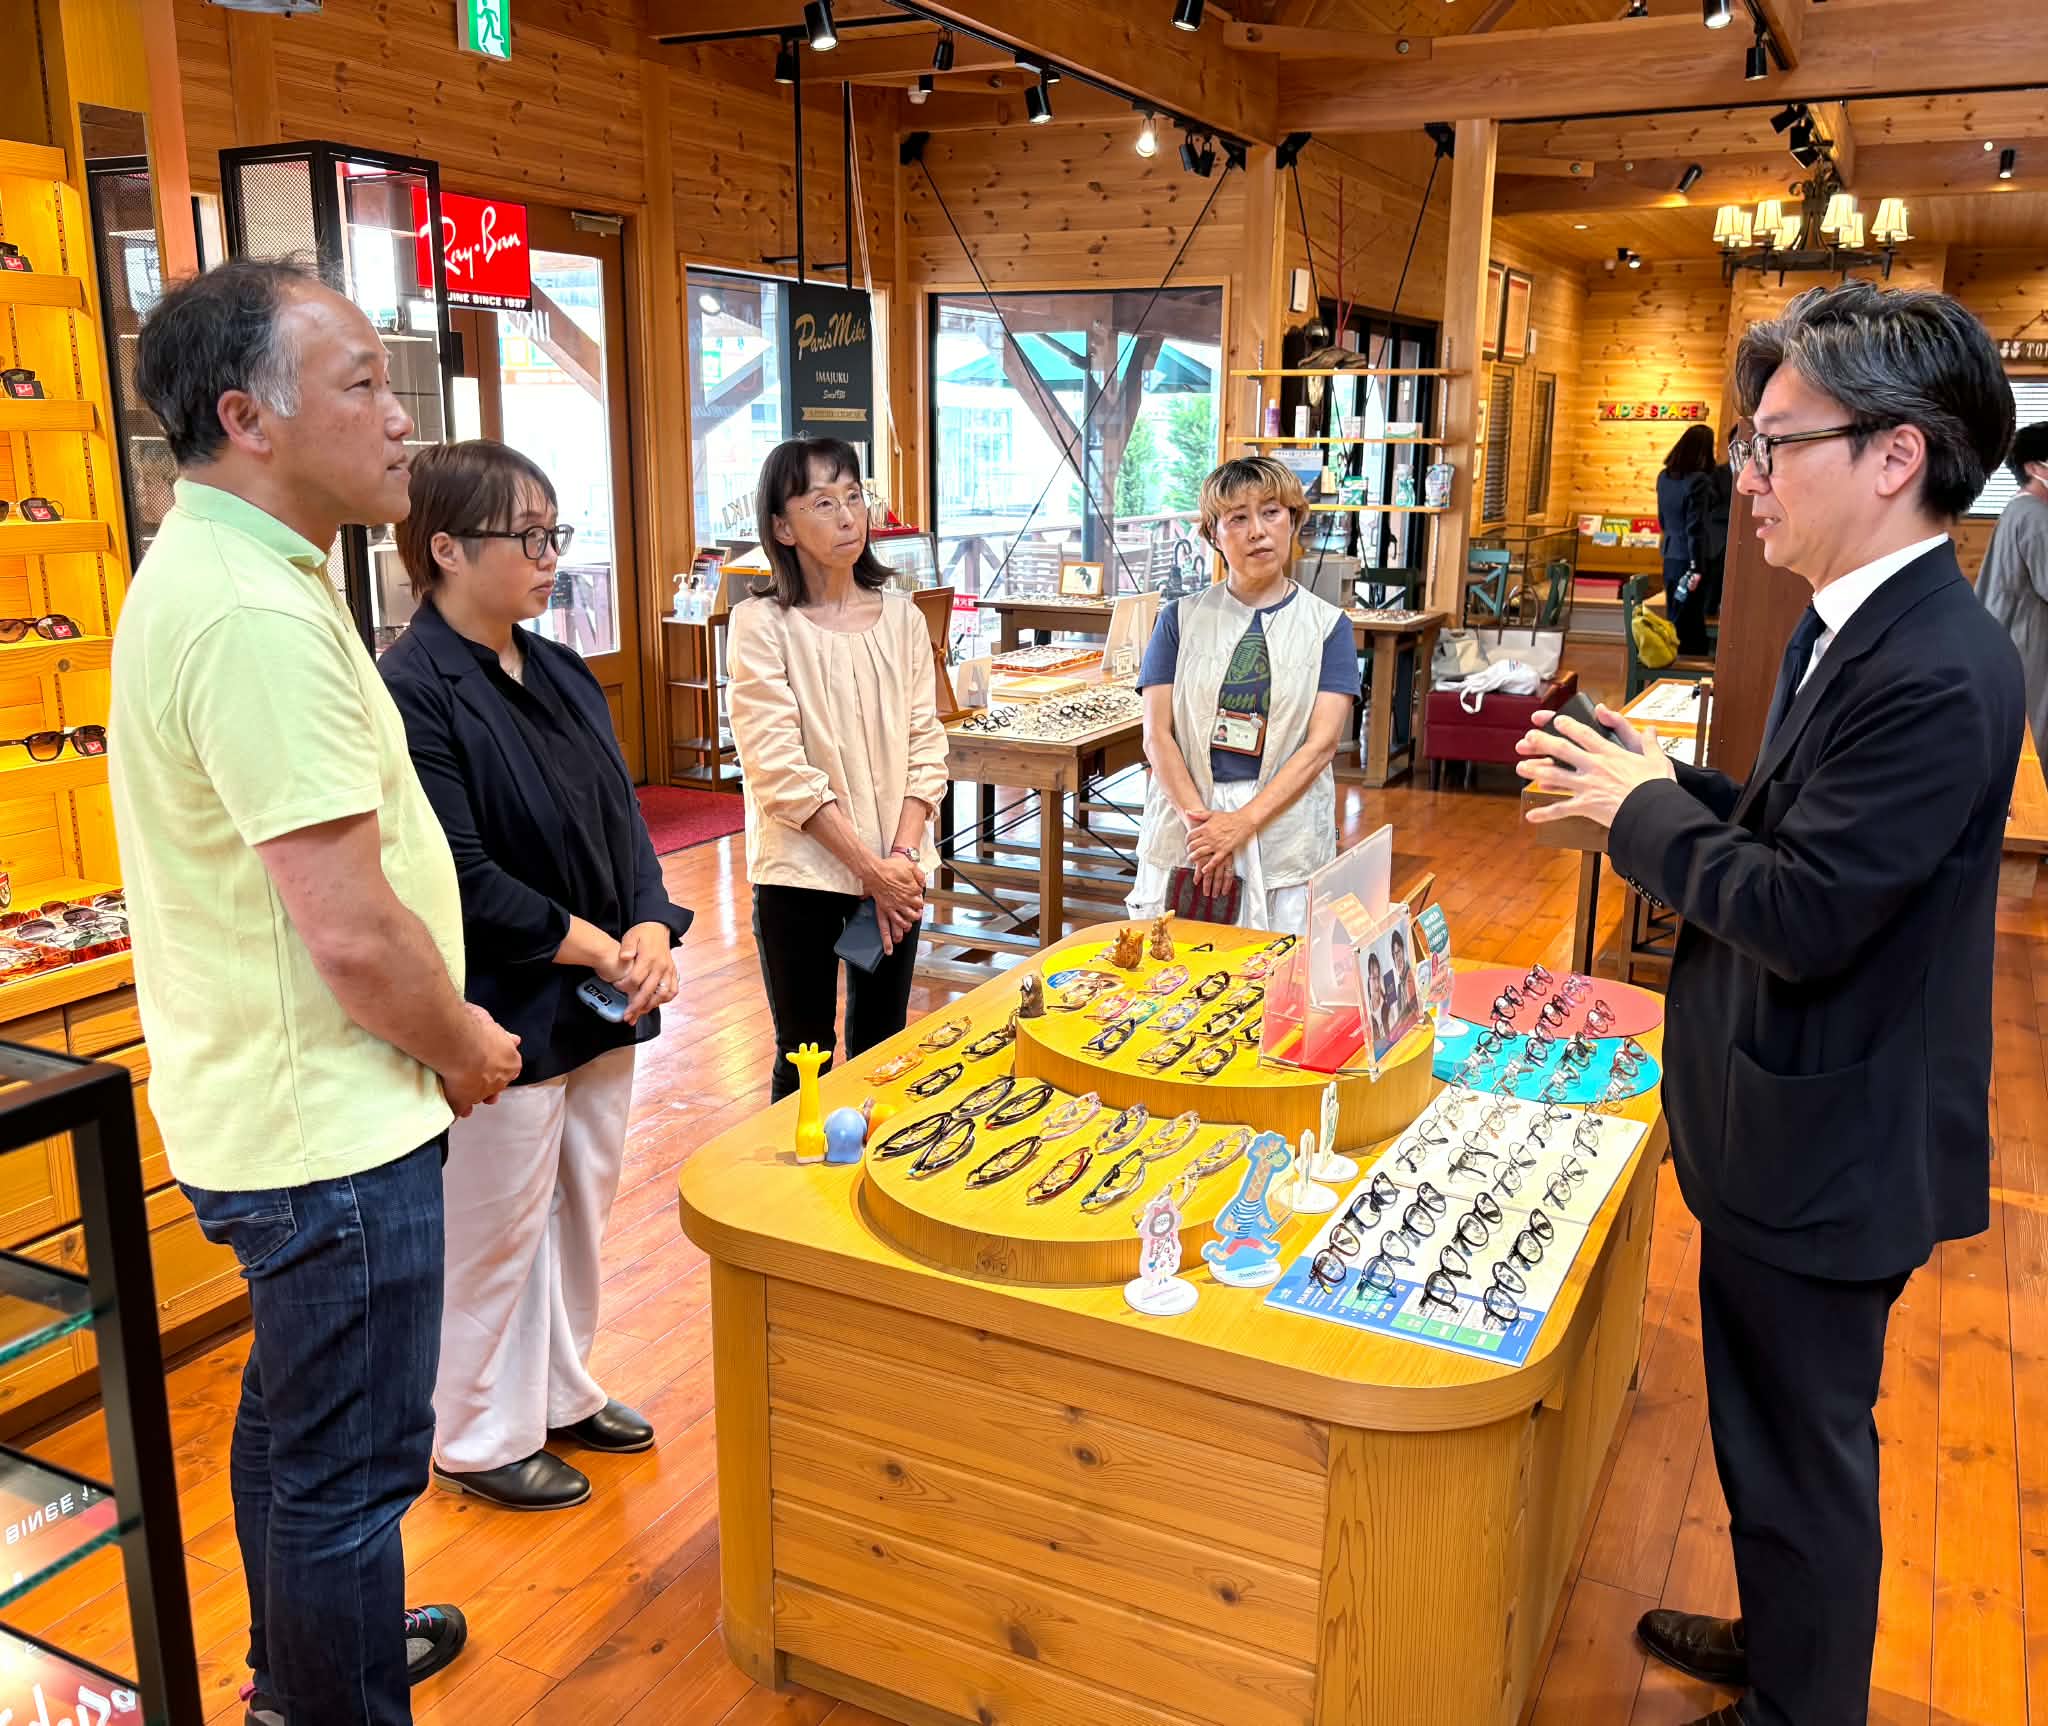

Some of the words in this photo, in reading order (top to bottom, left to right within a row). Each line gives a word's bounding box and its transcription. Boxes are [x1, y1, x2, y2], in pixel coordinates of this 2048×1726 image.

[815, 371, 849, 385] IMAJUKU
[1606, 403, 1645, 418] KID'S
[1649, 403, 1699, 418] SPACE
